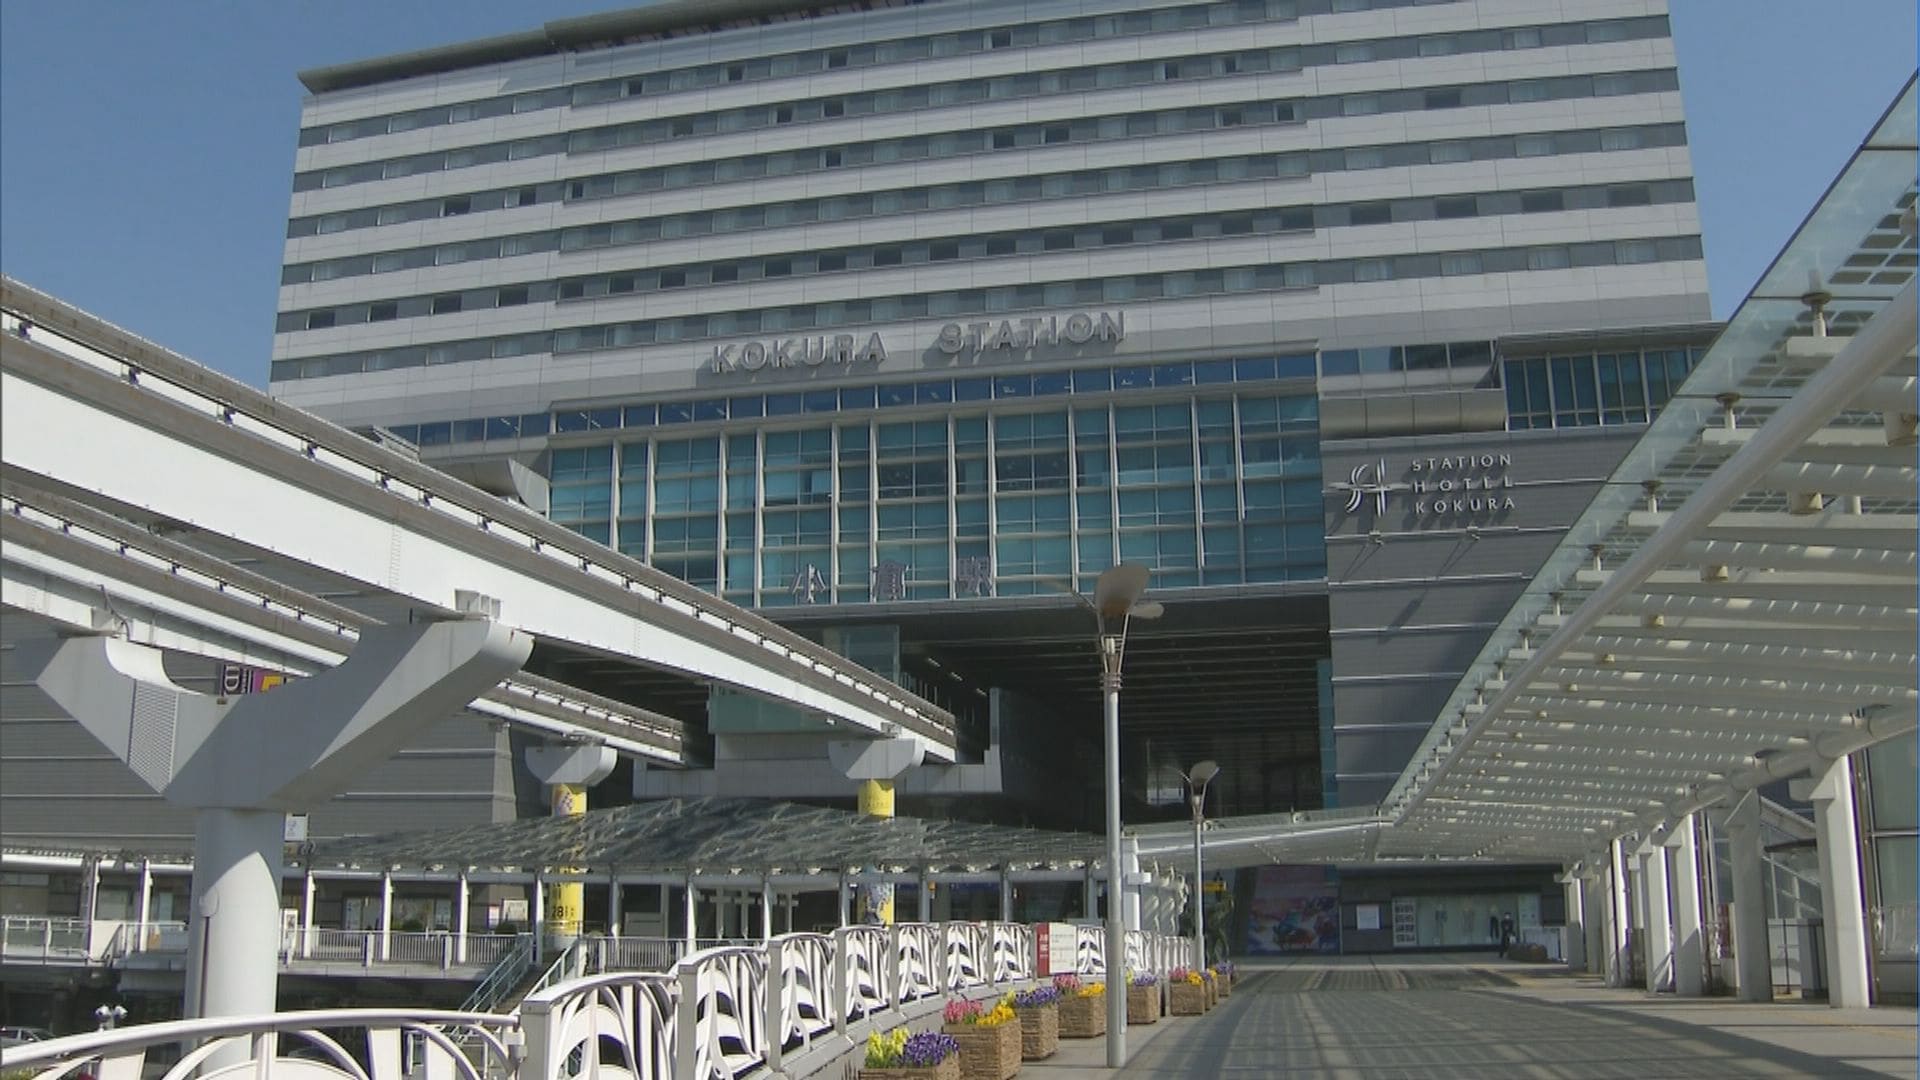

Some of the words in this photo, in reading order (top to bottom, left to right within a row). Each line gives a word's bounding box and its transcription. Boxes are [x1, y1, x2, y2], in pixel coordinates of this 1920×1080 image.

[711, 331, 889, 374] KOKURA
[938, 310, 1128, 354] STATION
[1412, 454, 1512, 472] STATION
[1414, 475, 1513, 493] HOTEL
[1415, 497, 1516, 514] KOKURA
